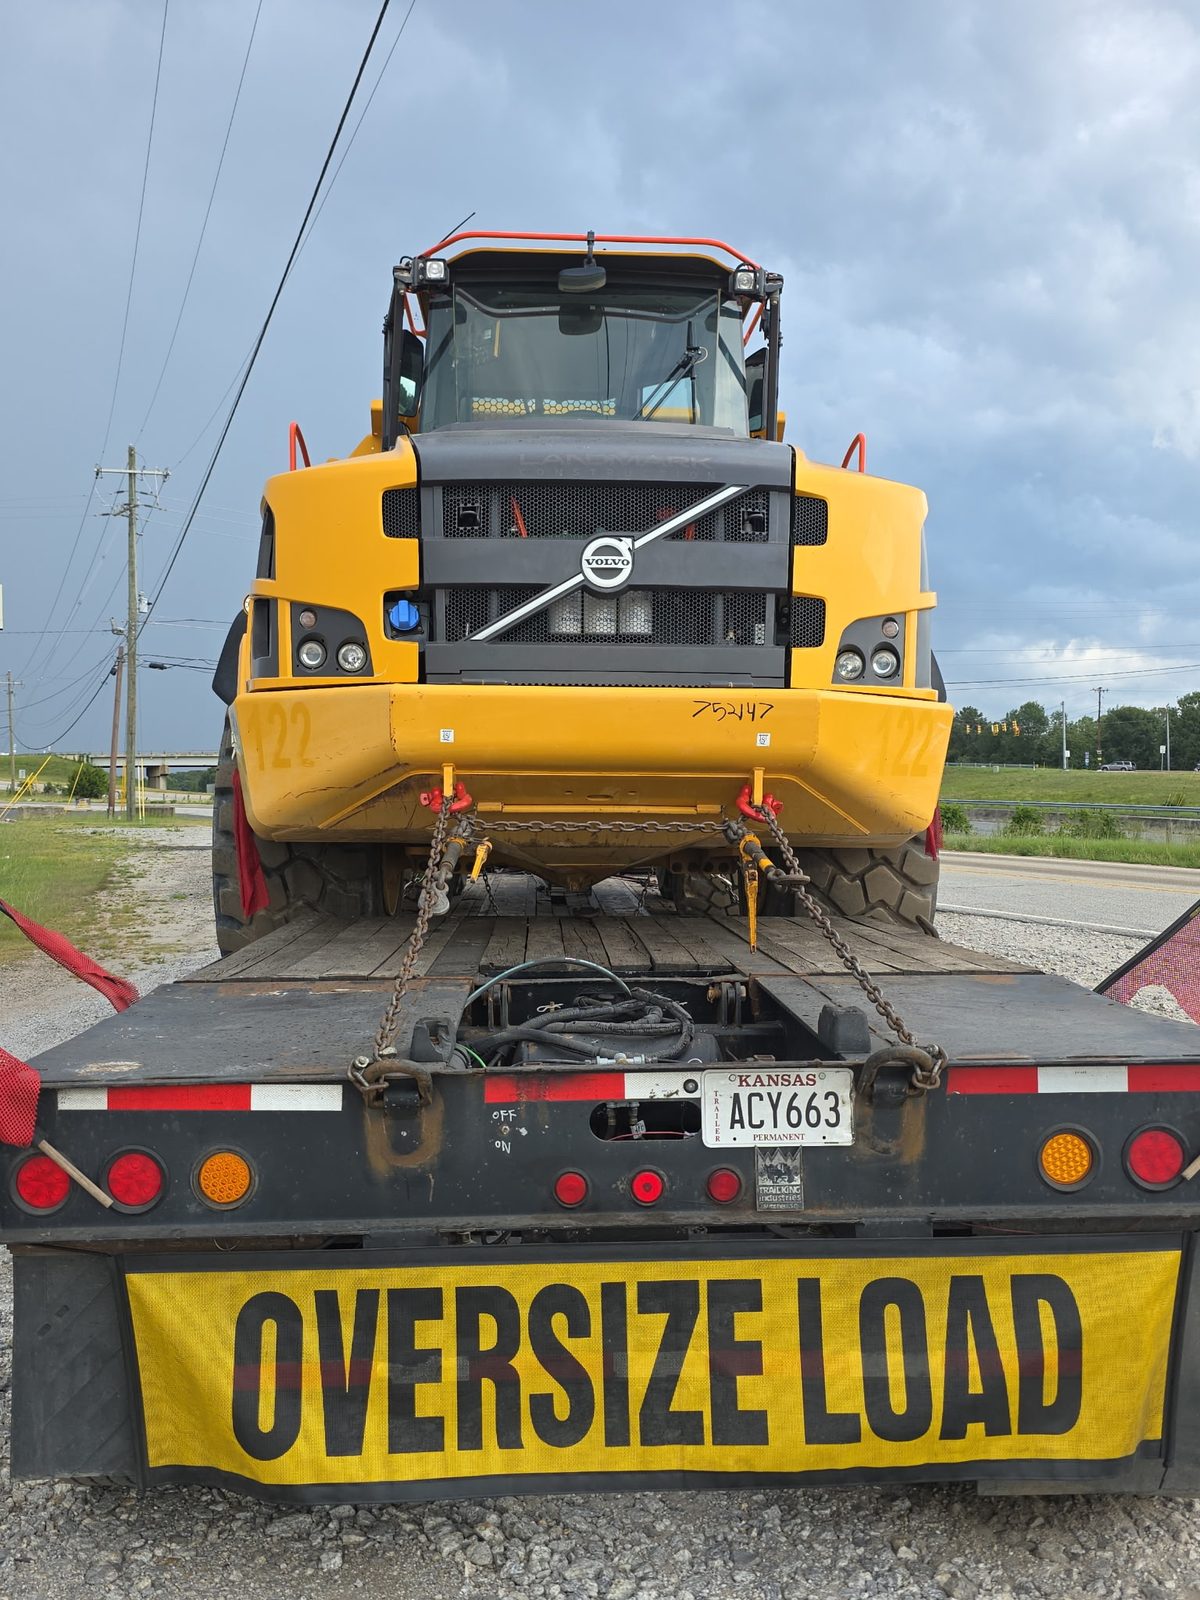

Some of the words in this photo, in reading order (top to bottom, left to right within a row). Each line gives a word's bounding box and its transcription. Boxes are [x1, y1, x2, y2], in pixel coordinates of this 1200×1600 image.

[519, 453, 713, 469] LANDMARK
[519, 468, 717, 481] CONSTRUTION
[584, 558, 631, 566] VOLVO
[692, 700, 775, 722] 752147
[247, 702, 315, 772] 122
[877, 707, 934, 777] 122
[737, 1073, 817, 1088] KANSAS
[492, 1109, 518, 1122] OFF
[713, 1090, 721, 1142] TRAILER
[729, 1091, 841, 1130] ACY663
[753, 1133, 806, 1142] PERMANENT
[494, 1140, 511, 1154] ON
[231, 1278, 769, 1461] OVERSIZE
[797, 1273, 1083, 1445] LOAD
